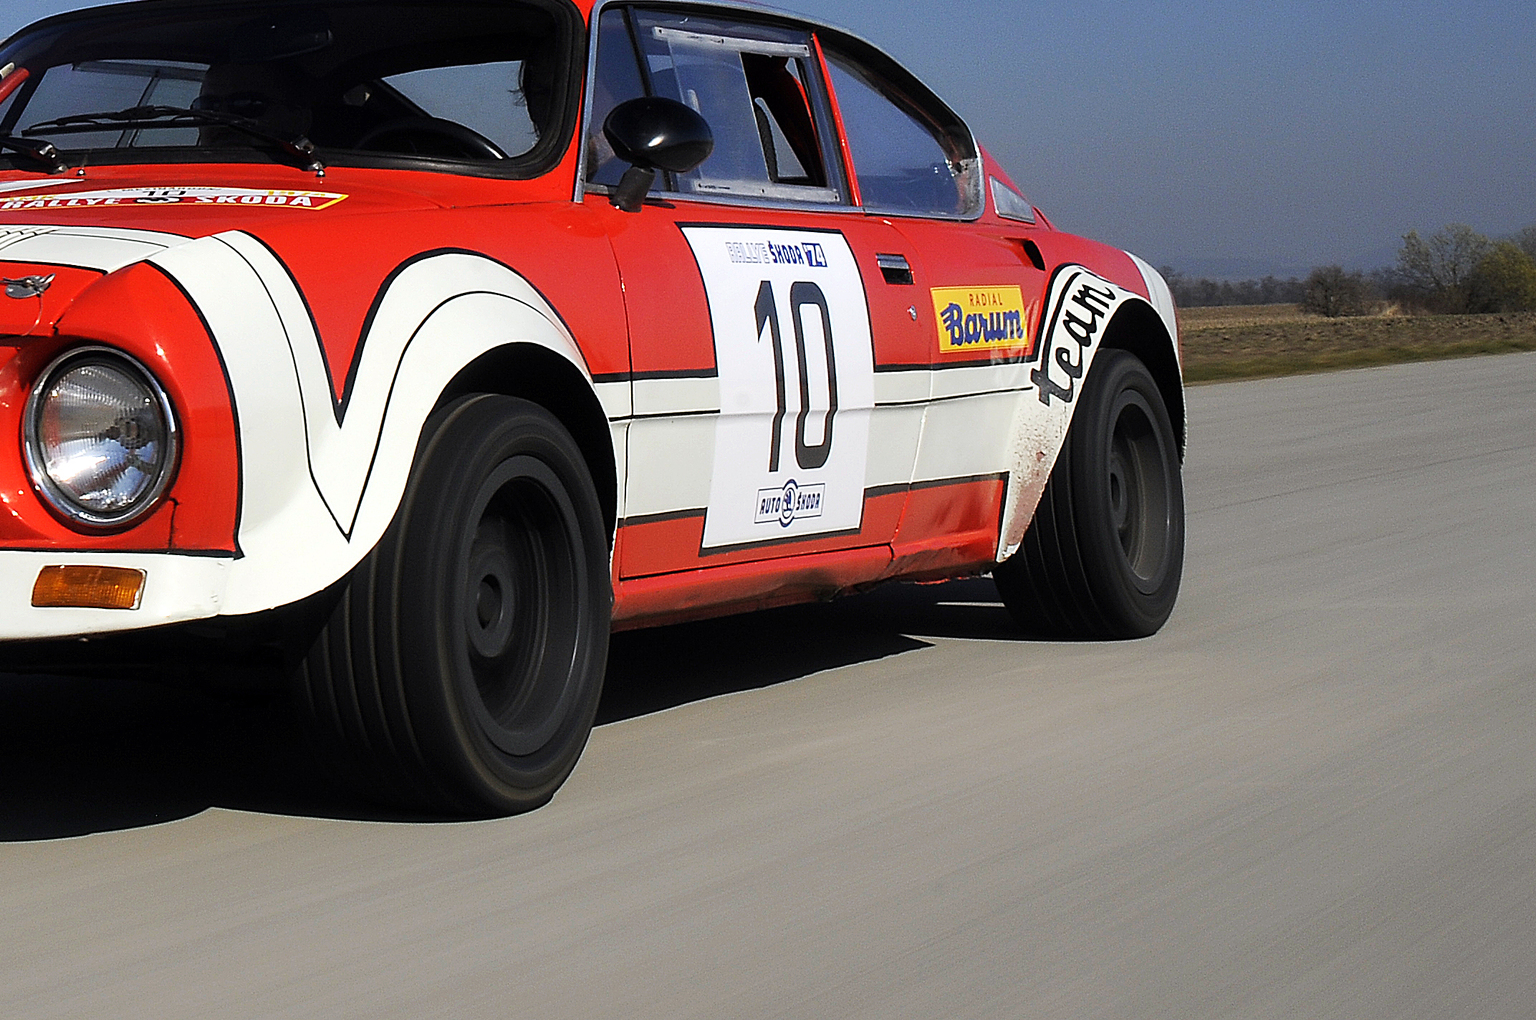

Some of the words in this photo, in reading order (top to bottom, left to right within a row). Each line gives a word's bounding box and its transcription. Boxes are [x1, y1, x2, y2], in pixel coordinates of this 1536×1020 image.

[969, 293, 1003, 306] RADIAL
[940, 302, 1023, 346] Barum
[1031, 271, 1116, 407] team
[754, 280, 838, 472] 10
[759, 497, 781, 514] AUTO
